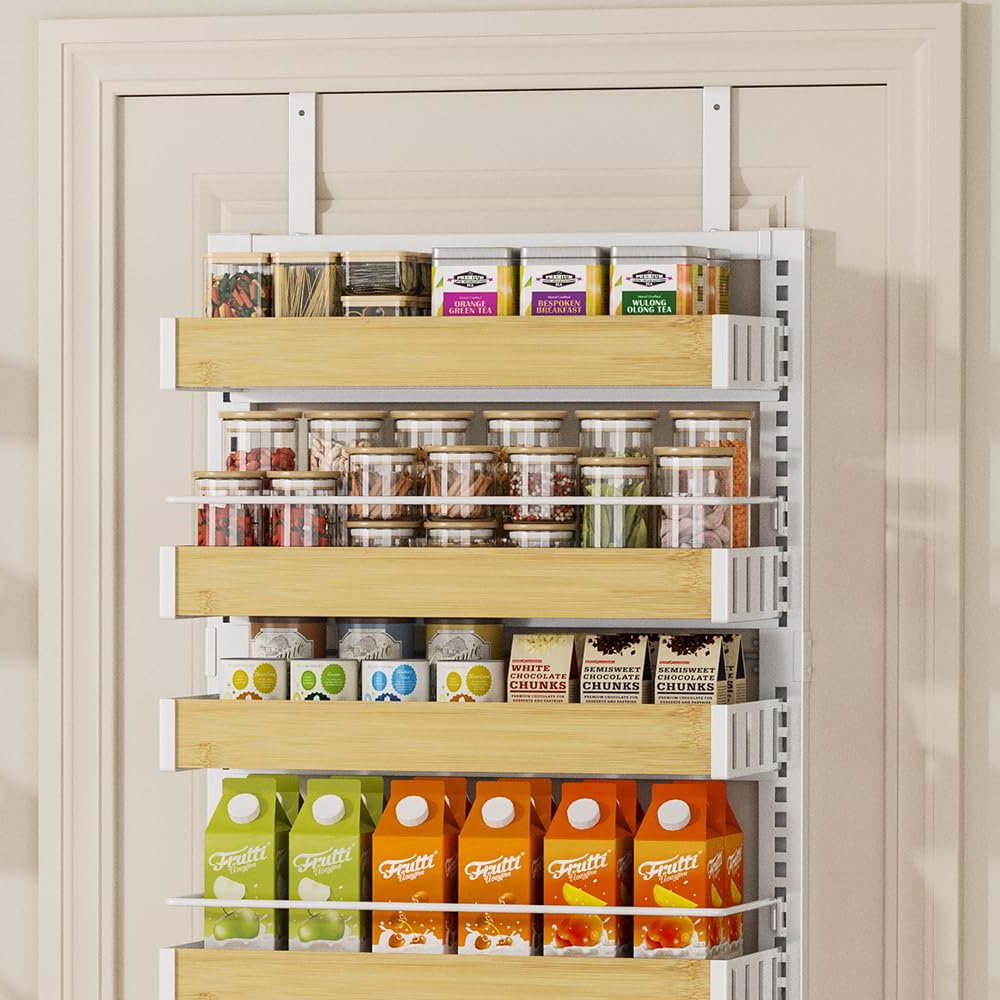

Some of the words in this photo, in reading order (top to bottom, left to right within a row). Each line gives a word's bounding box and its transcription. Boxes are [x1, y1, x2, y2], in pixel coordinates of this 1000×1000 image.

[510, 681, 566, 689] CHUNKS
[583, 682, 640, 690] CHUNKS
[657, 683, 714, 691] CHUNKS
[208, 842, 270, 872] Frutti
[293, 843, 356, 872] Frutti
[378, 850, 438, 880] Frutti
[464, 851, 525, 880] Frutti
[548, 850, 611, 879] Frutti
[638, 850, 702, 880] Frutti
